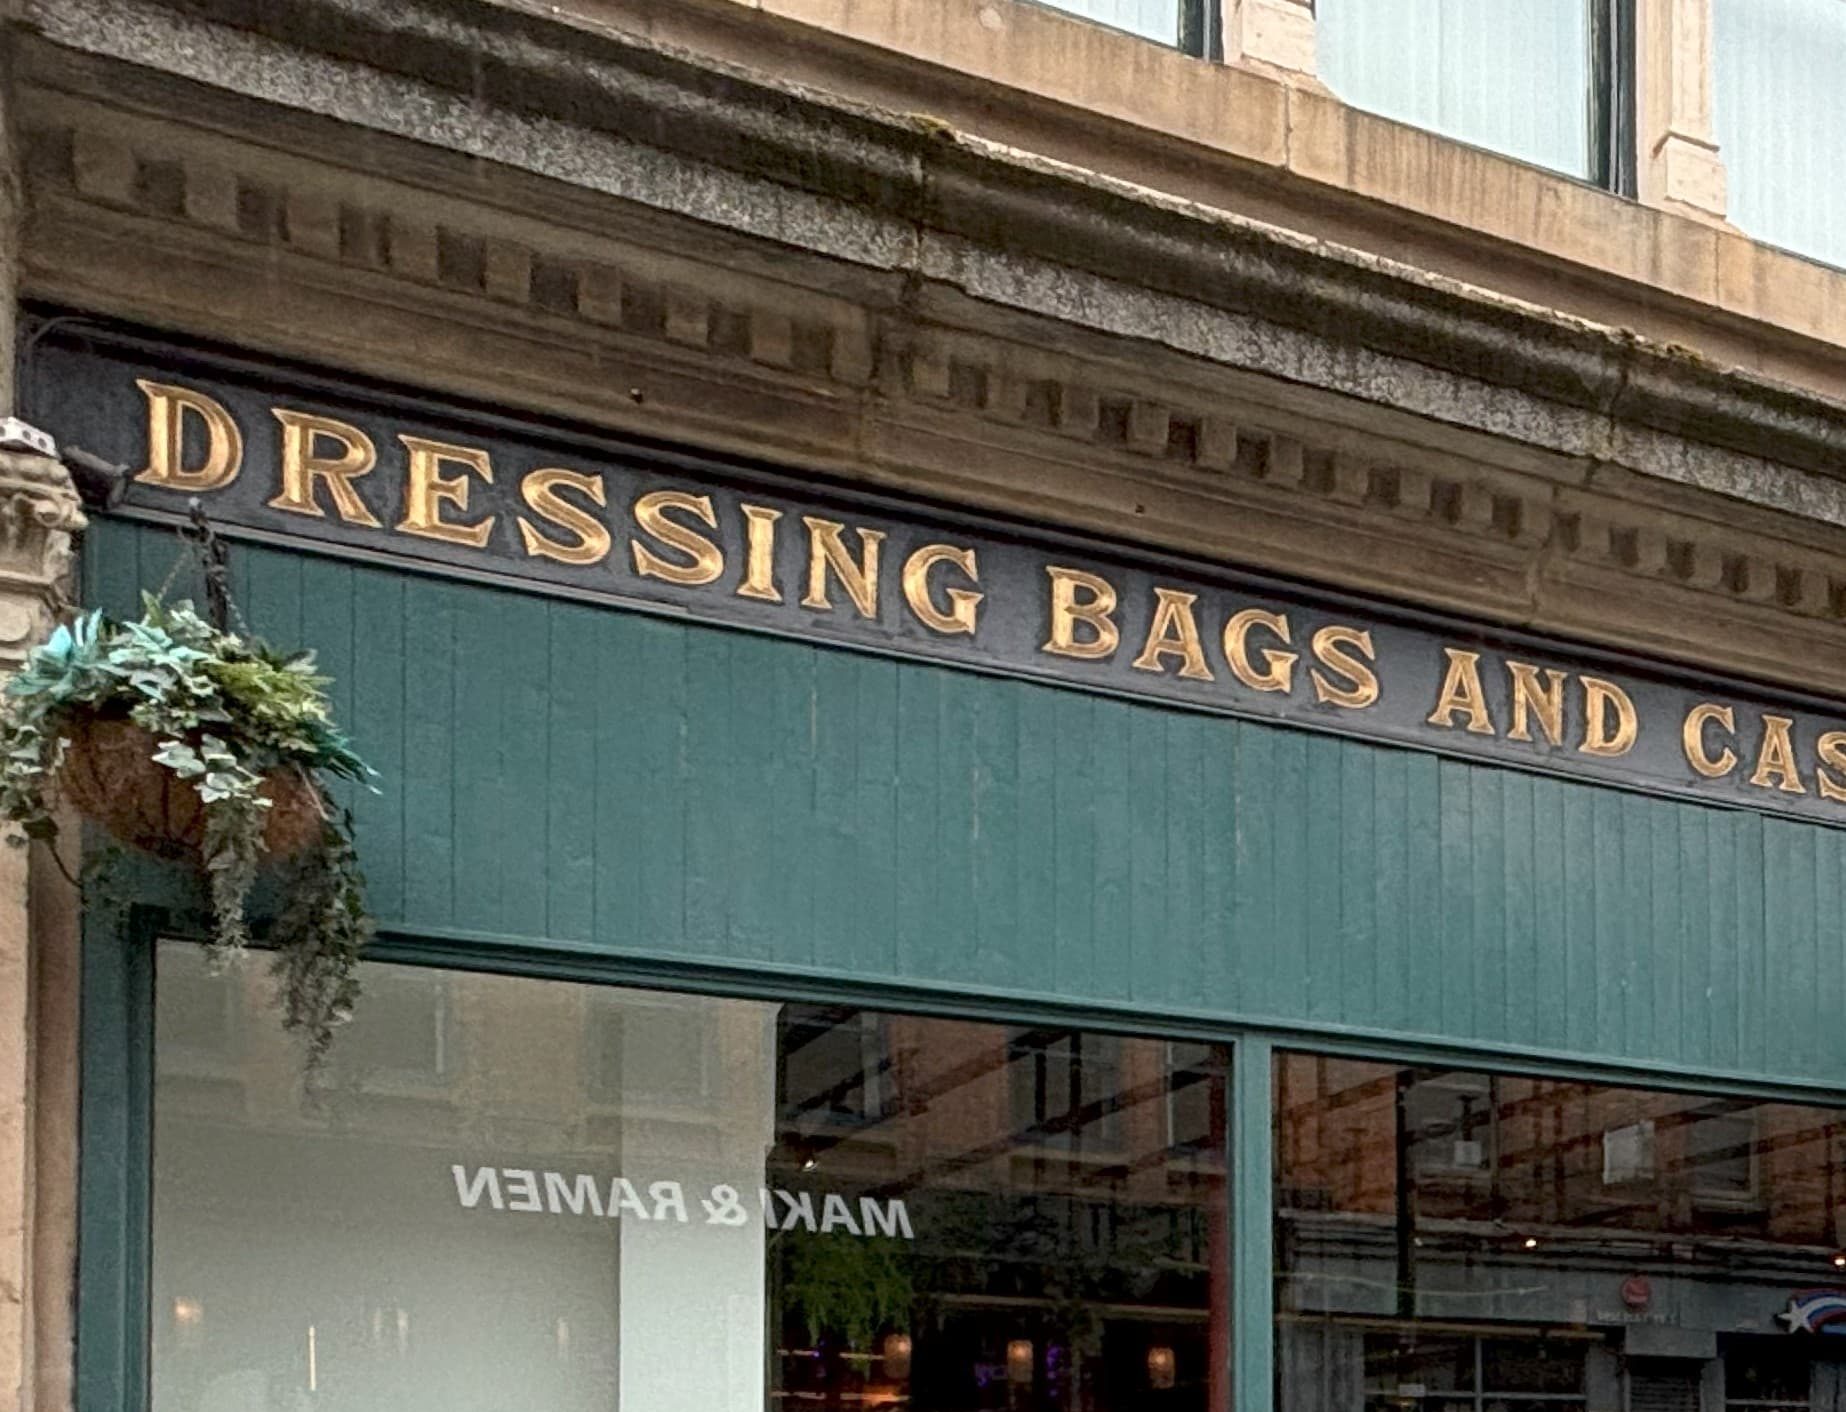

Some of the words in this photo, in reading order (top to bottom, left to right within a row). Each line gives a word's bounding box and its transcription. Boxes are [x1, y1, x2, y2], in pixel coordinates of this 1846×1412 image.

[135, 378, 984, 636] DRESSING
[1042, 565, 1379, 709] BAGS
[1428, 648, 1638, 758] AND
